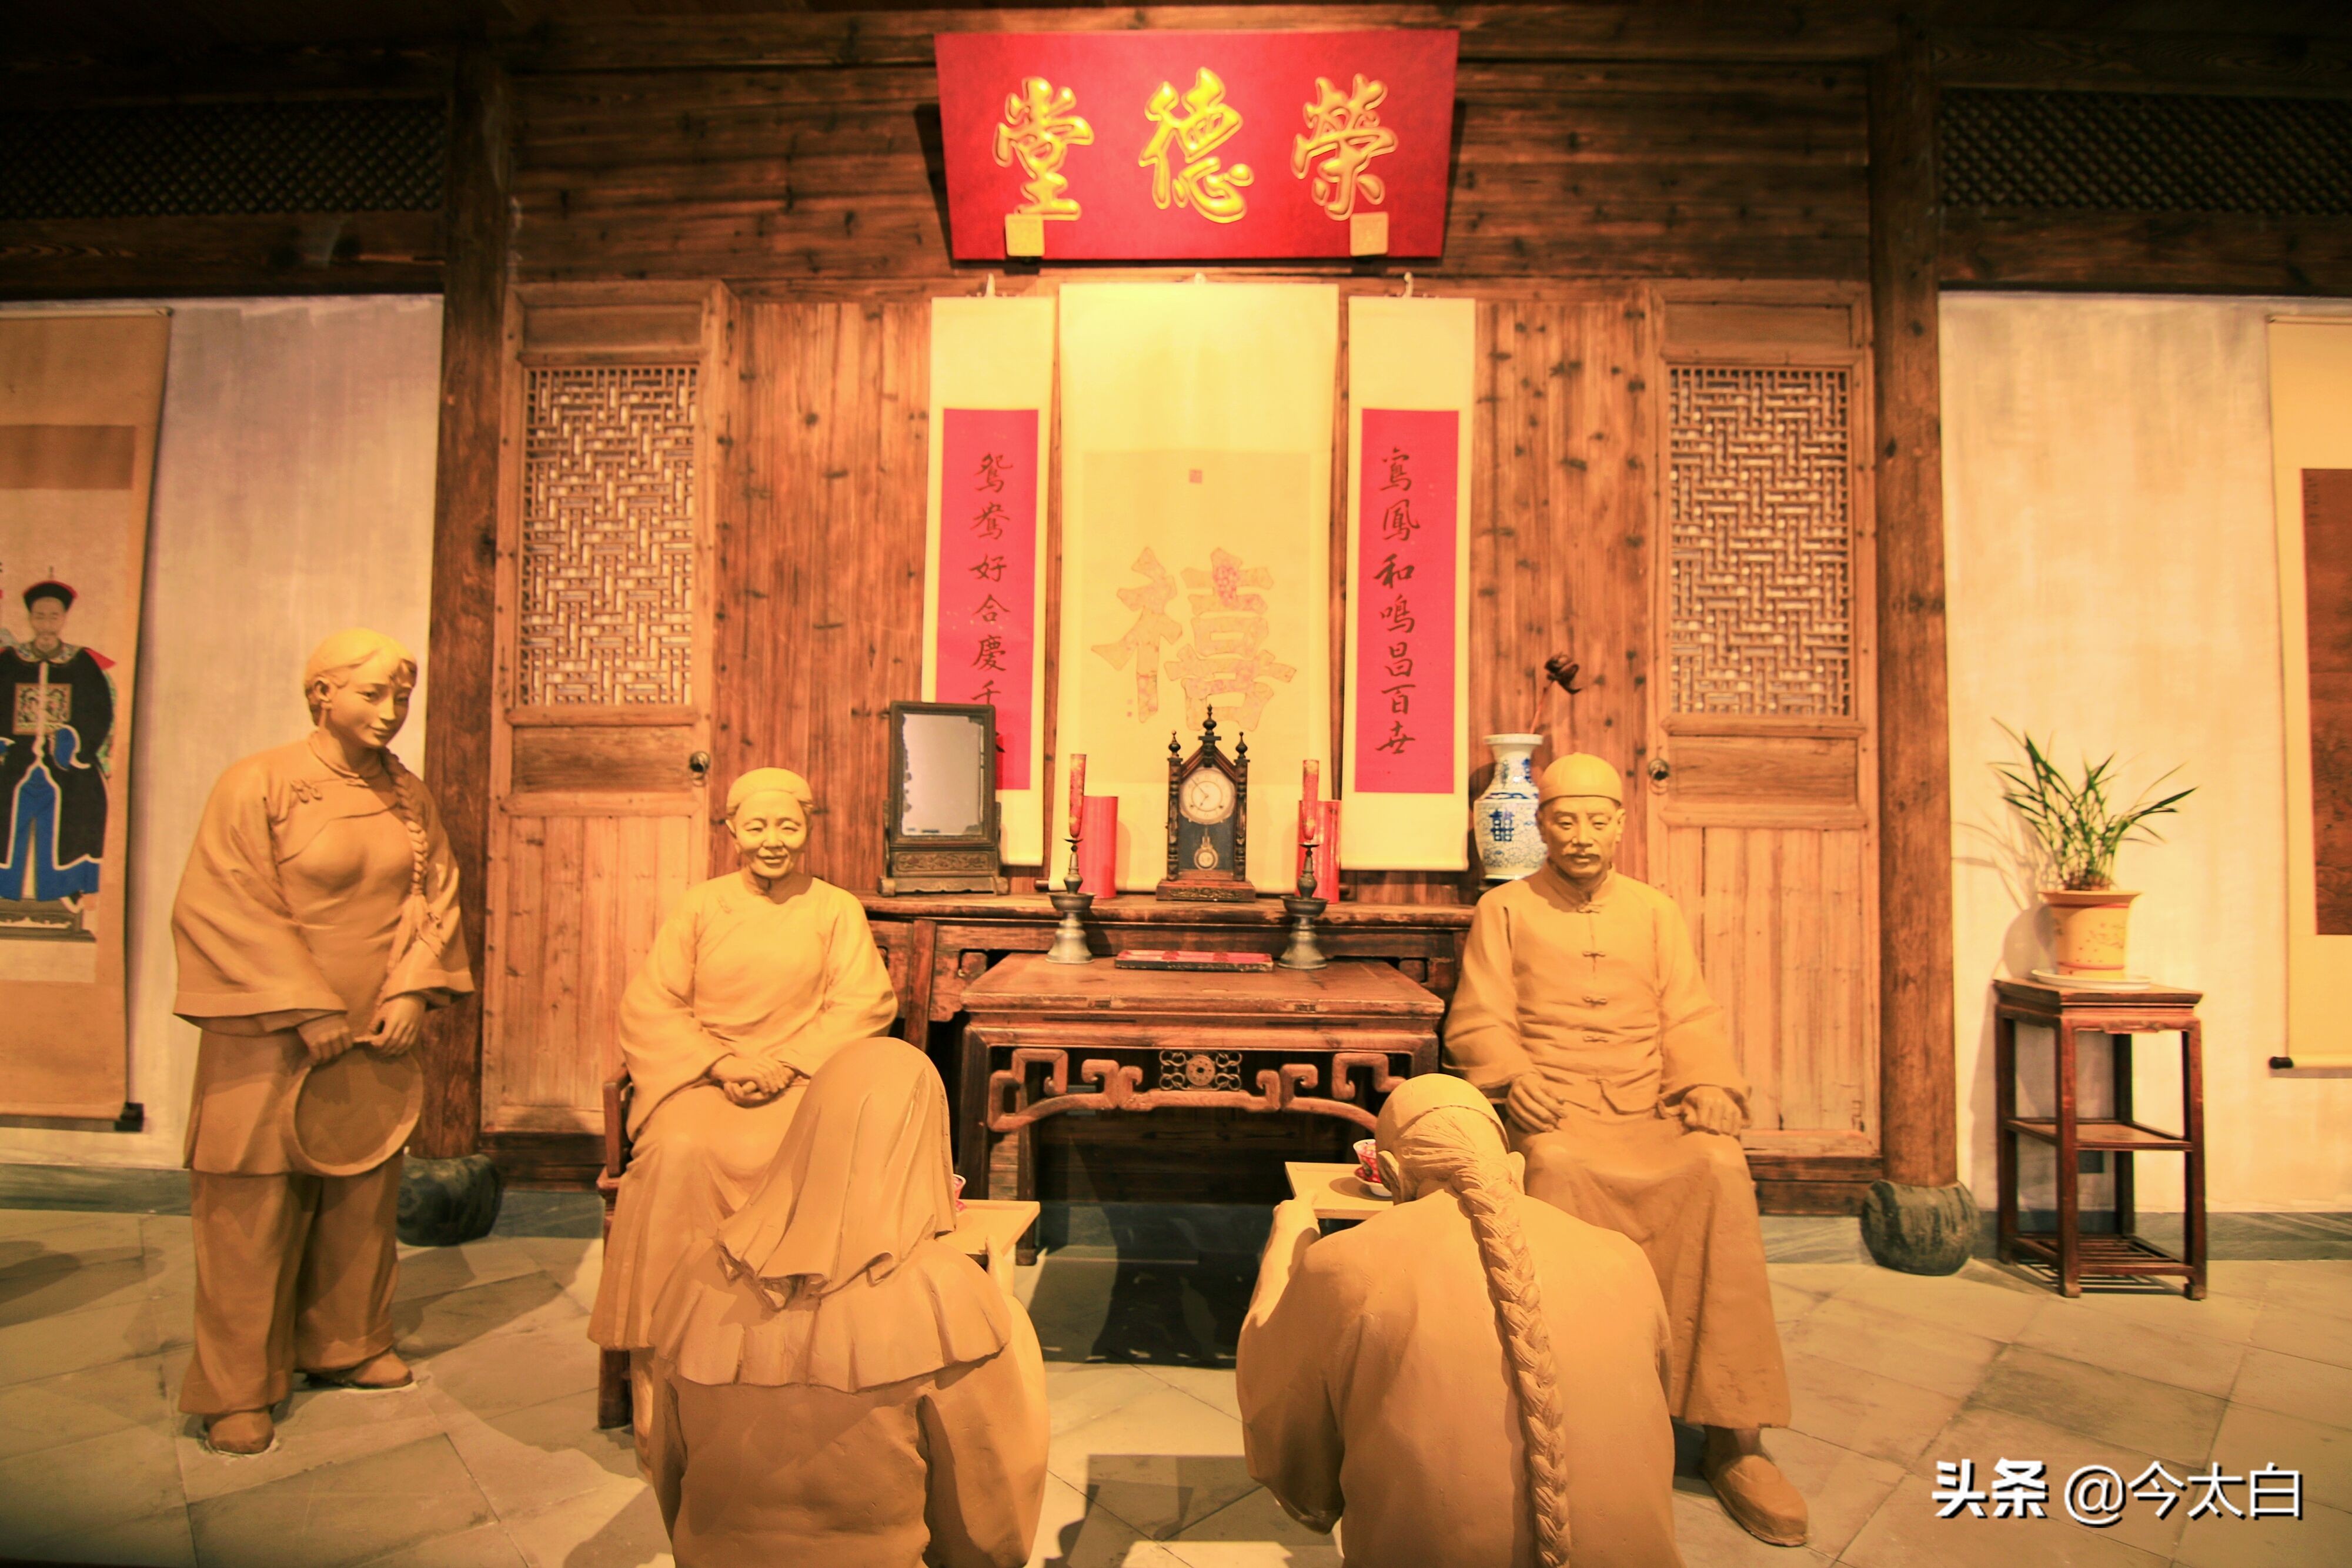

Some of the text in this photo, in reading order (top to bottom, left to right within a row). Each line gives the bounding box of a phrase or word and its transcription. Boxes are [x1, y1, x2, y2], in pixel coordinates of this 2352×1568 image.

[967, 453, 1014, 753] 鴛鴦好合慶千
